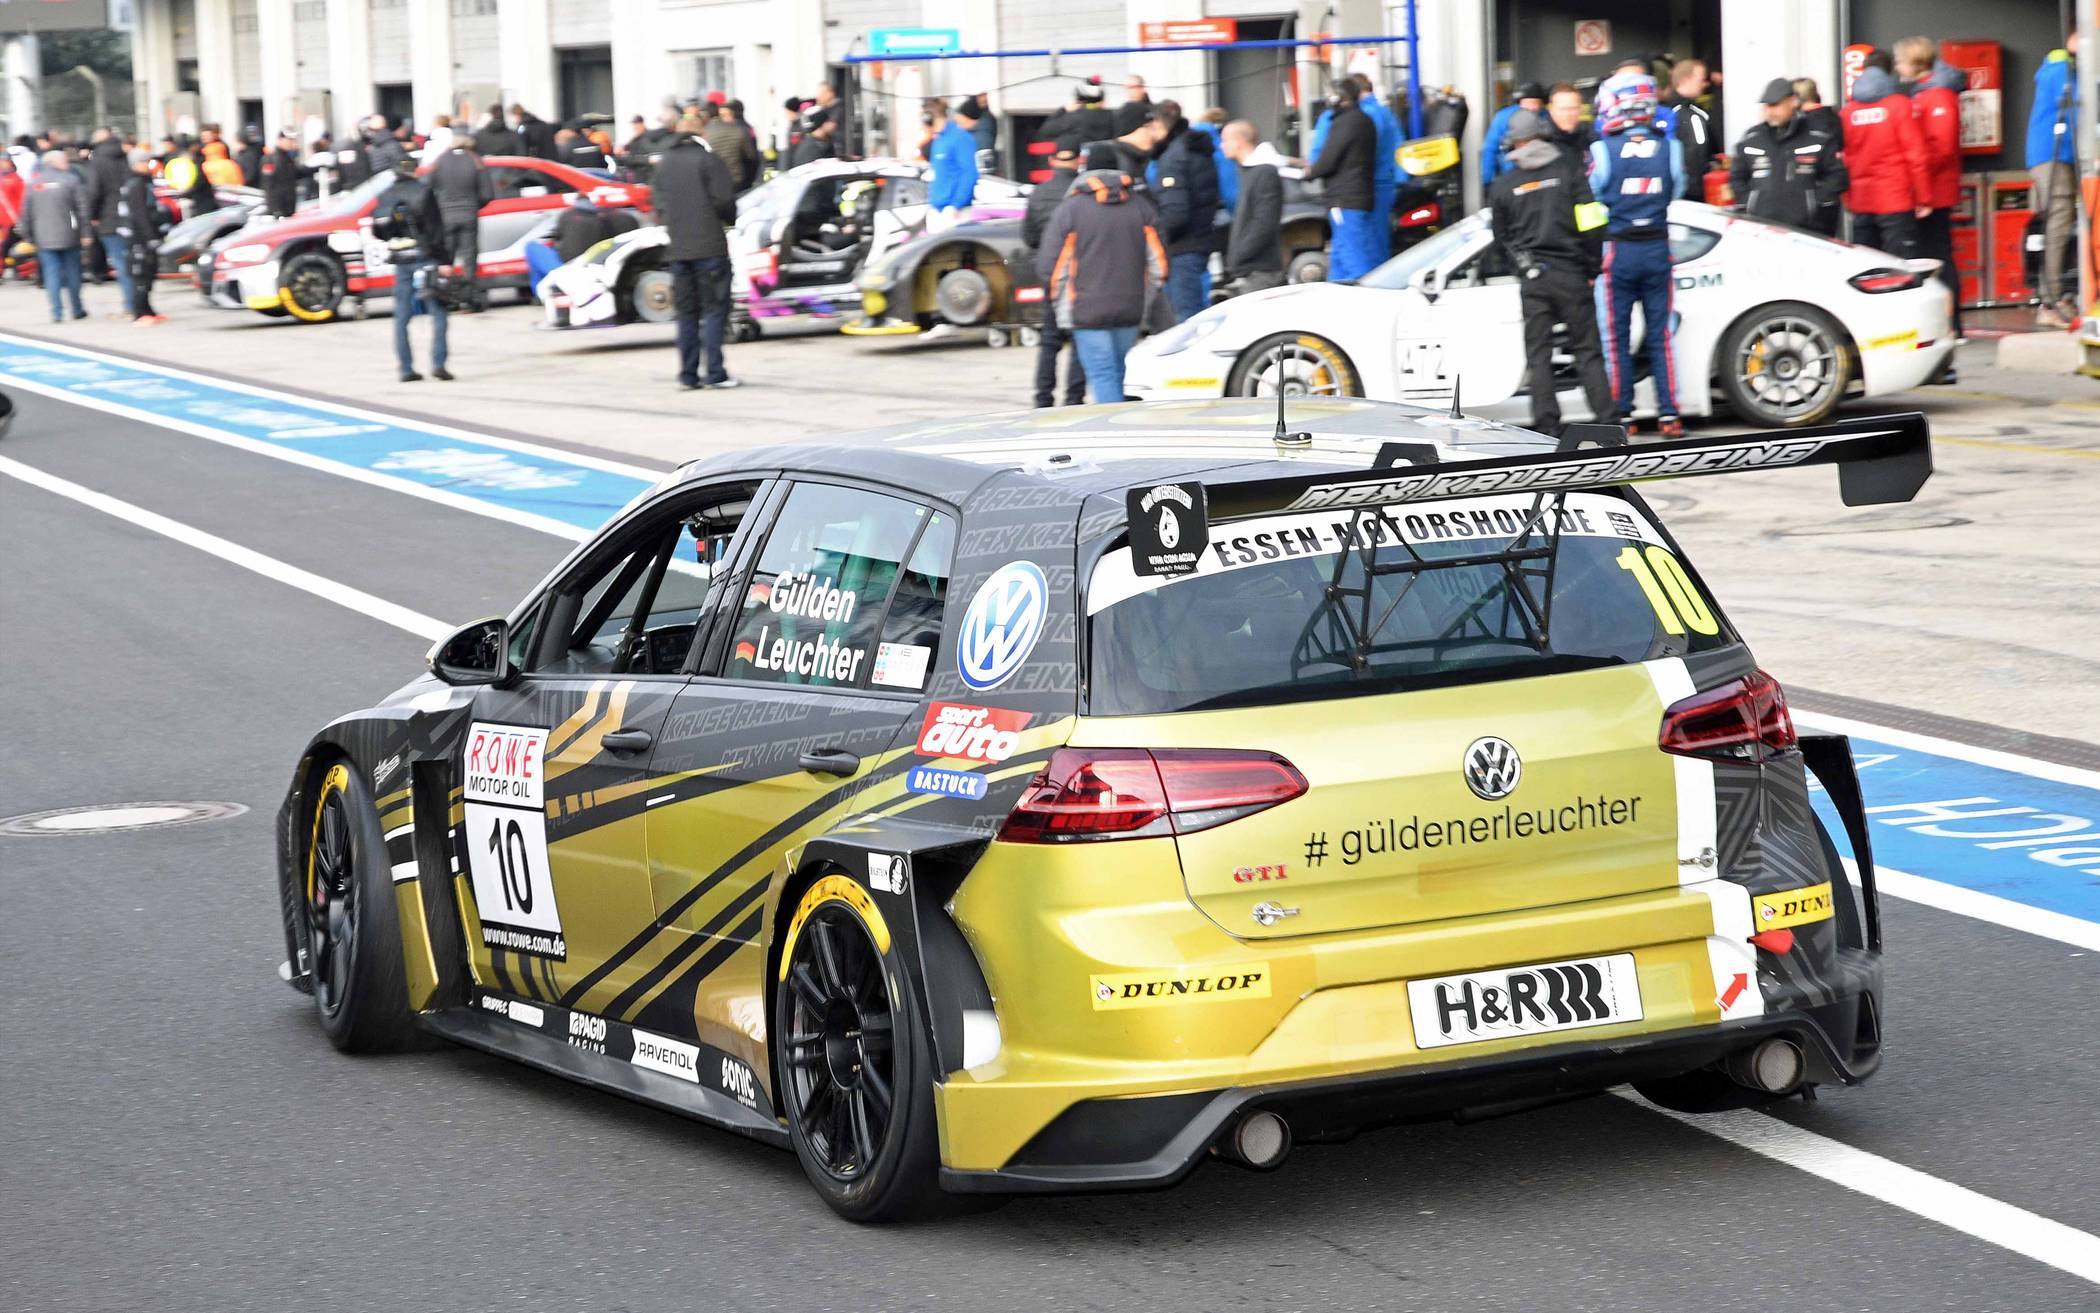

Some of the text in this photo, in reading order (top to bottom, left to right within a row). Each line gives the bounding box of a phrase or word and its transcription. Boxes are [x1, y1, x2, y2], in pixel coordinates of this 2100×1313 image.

[1298, 440, 1819, 509] MAX KRAUSE RACING
[1211, 508, 1596, 568] ESSEN-MOTORSHOWDE
[769, 571, 856, 623] Gülden
[1616, 545, 1719, 636] 10
[754, 625, 865, 682] Leuchter
[936, 706, 989, 727] sport
[469, 734, 537, 779] ROWE
[921, 723, 1020, 761] auto
[469, 775, 531, 799] MOTOR OIL
[914, 771, 979, 796] BASTUCK
[1341, 795, 1642, 866] güldenerleuchter
[488, 817, 534, 916] 10
[1233, 864, 1288, 883] GTI
[482, 927, 567, 957] www.rowe.com.de
[1120, 972, 1263, 999] DUNLOP
[1435, 968, 1562, 1038] H&R
[568, 1036, 606, 1055] RACING
[577, 1013, 607, 1042] PAGID
[639, 1041, 693, 1071] RAVENOL
[721, 1056, 755, 1100] SONIC
